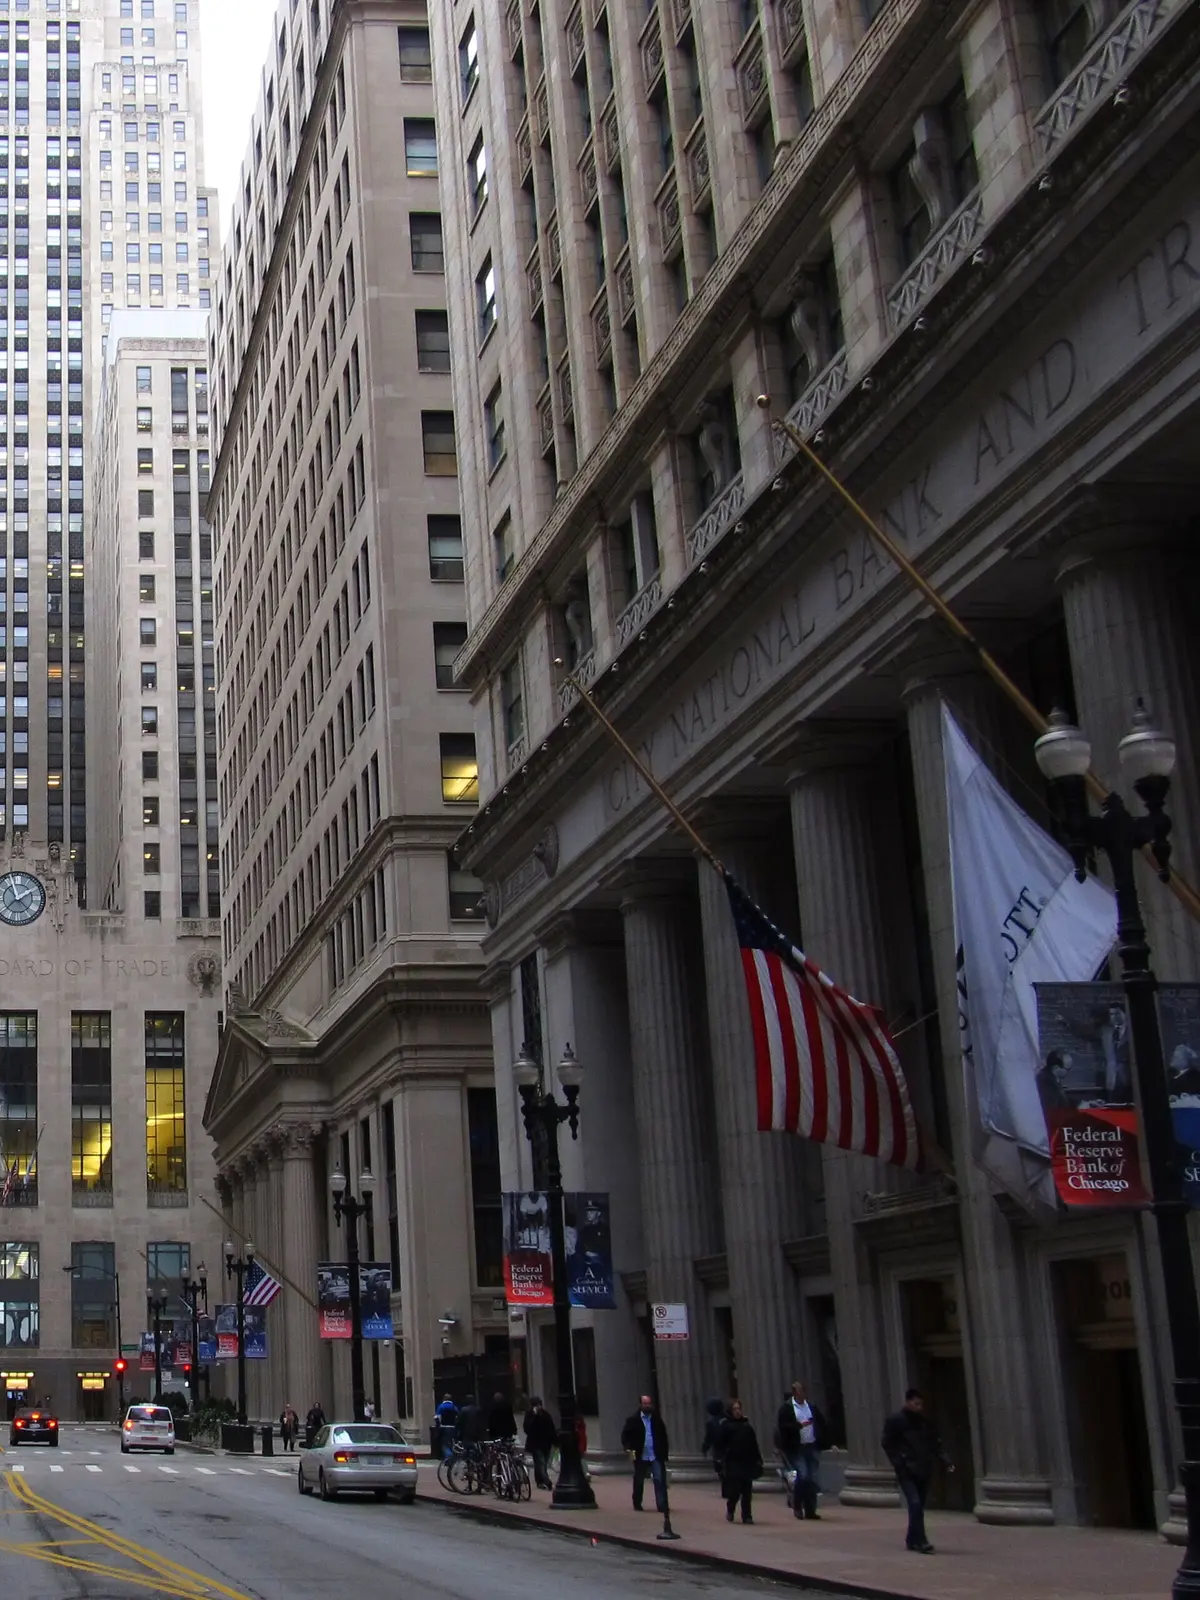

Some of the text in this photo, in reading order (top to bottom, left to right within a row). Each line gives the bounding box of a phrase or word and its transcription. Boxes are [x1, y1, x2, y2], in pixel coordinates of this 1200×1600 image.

[668, 592, 816, 758] NATIONAL
[829, 461, 943, 611] BANK
[973, 338, 1076, 486] AND
[64, 959, 94, 977] OF
[101, 959, 171, 977] TRADE
[1063, 1126, 1122, 1142] Federal
[1064, 1142, 1124, 1158] Reserve
[1065, 1158, 1126, 1177] Bank of
[1067, 1174, 1129, 1193] Chicago
[511, 1263, 543, 1273] Federal
[584, 1267, 596, 1279] A
[511, 1272, 543, 1281] Reserve
[512, 1280, 535, 1288] Bank
[512, 1288, 545, 1298] Chicago
[371, 1311, 380, 1320] A
